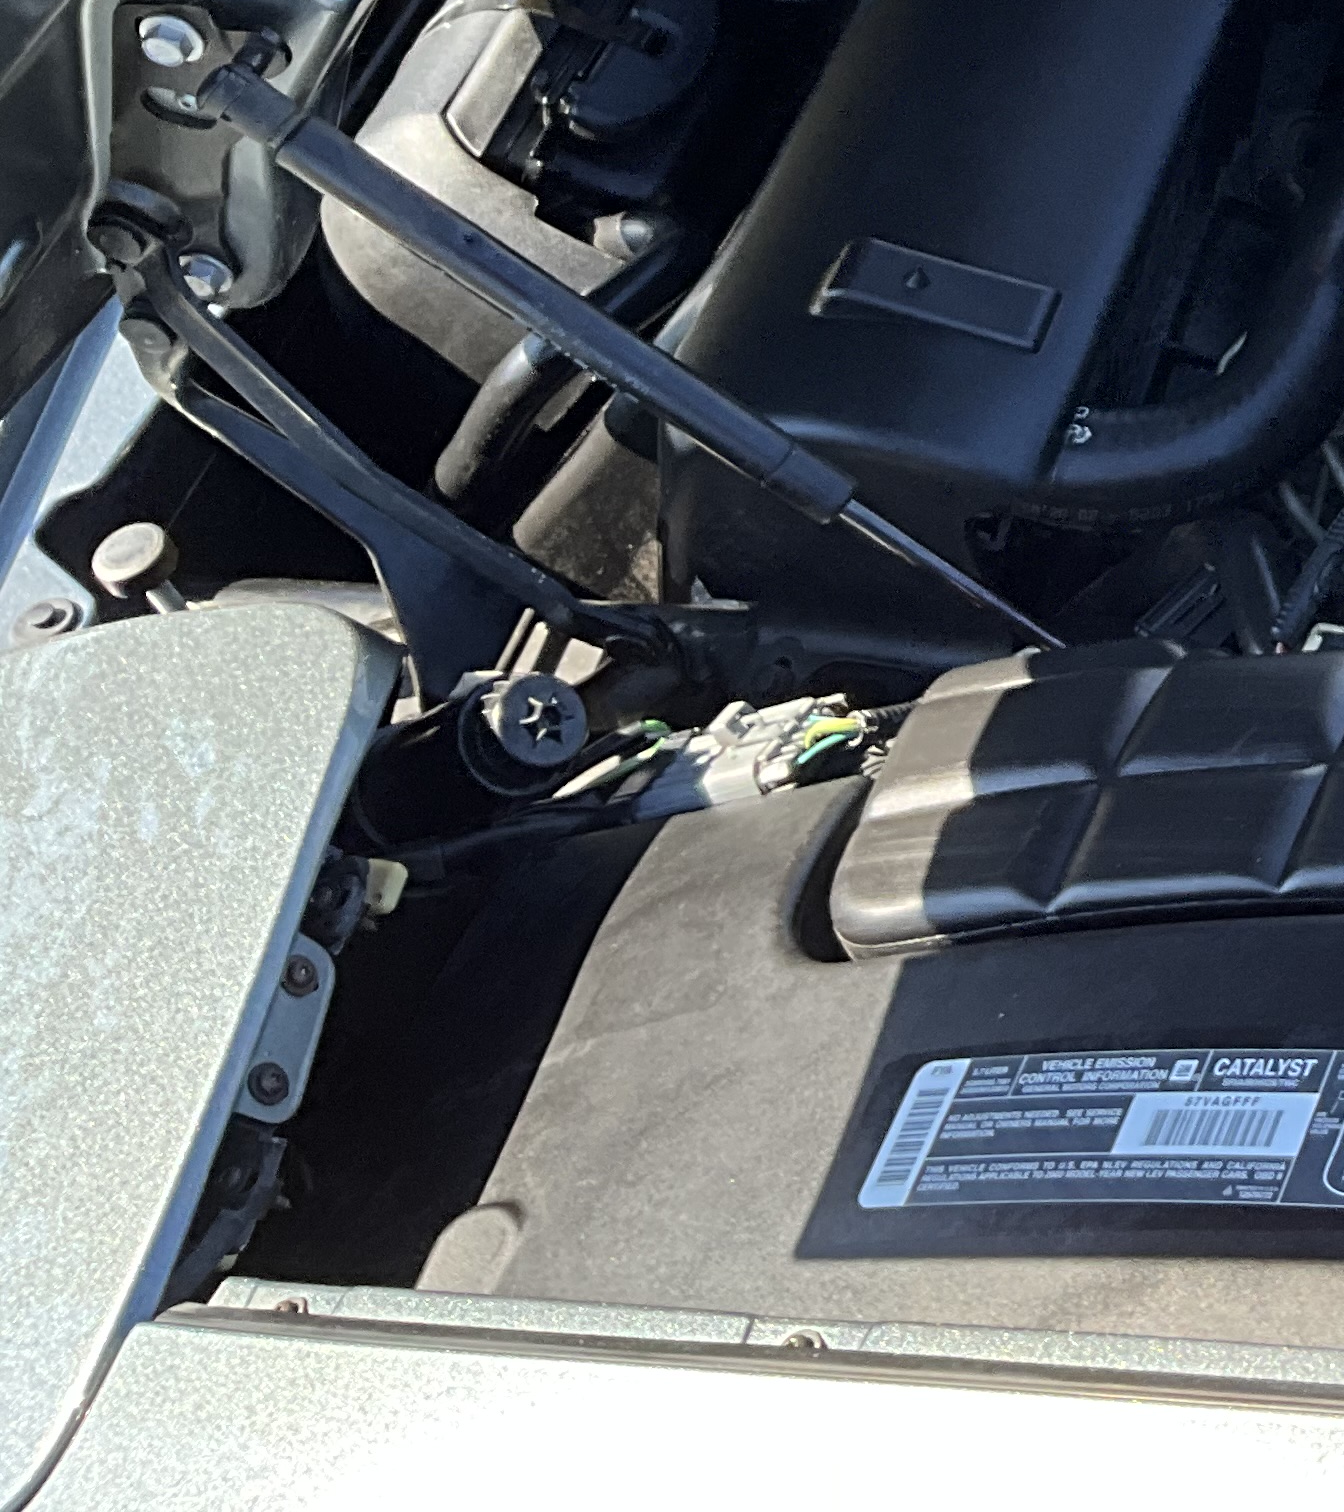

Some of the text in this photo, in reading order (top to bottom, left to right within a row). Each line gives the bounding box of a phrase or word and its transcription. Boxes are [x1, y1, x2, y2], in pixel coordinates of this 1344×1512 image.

[1041, 1057, 1157, 1071] VEHICLE EMISSION
[1213, 1058, 1318, 1078] CATALYST
[1018, 1071, 1076, 1085] CONTROL
[1081, 1068, 1170, 1083] INFORMATION
